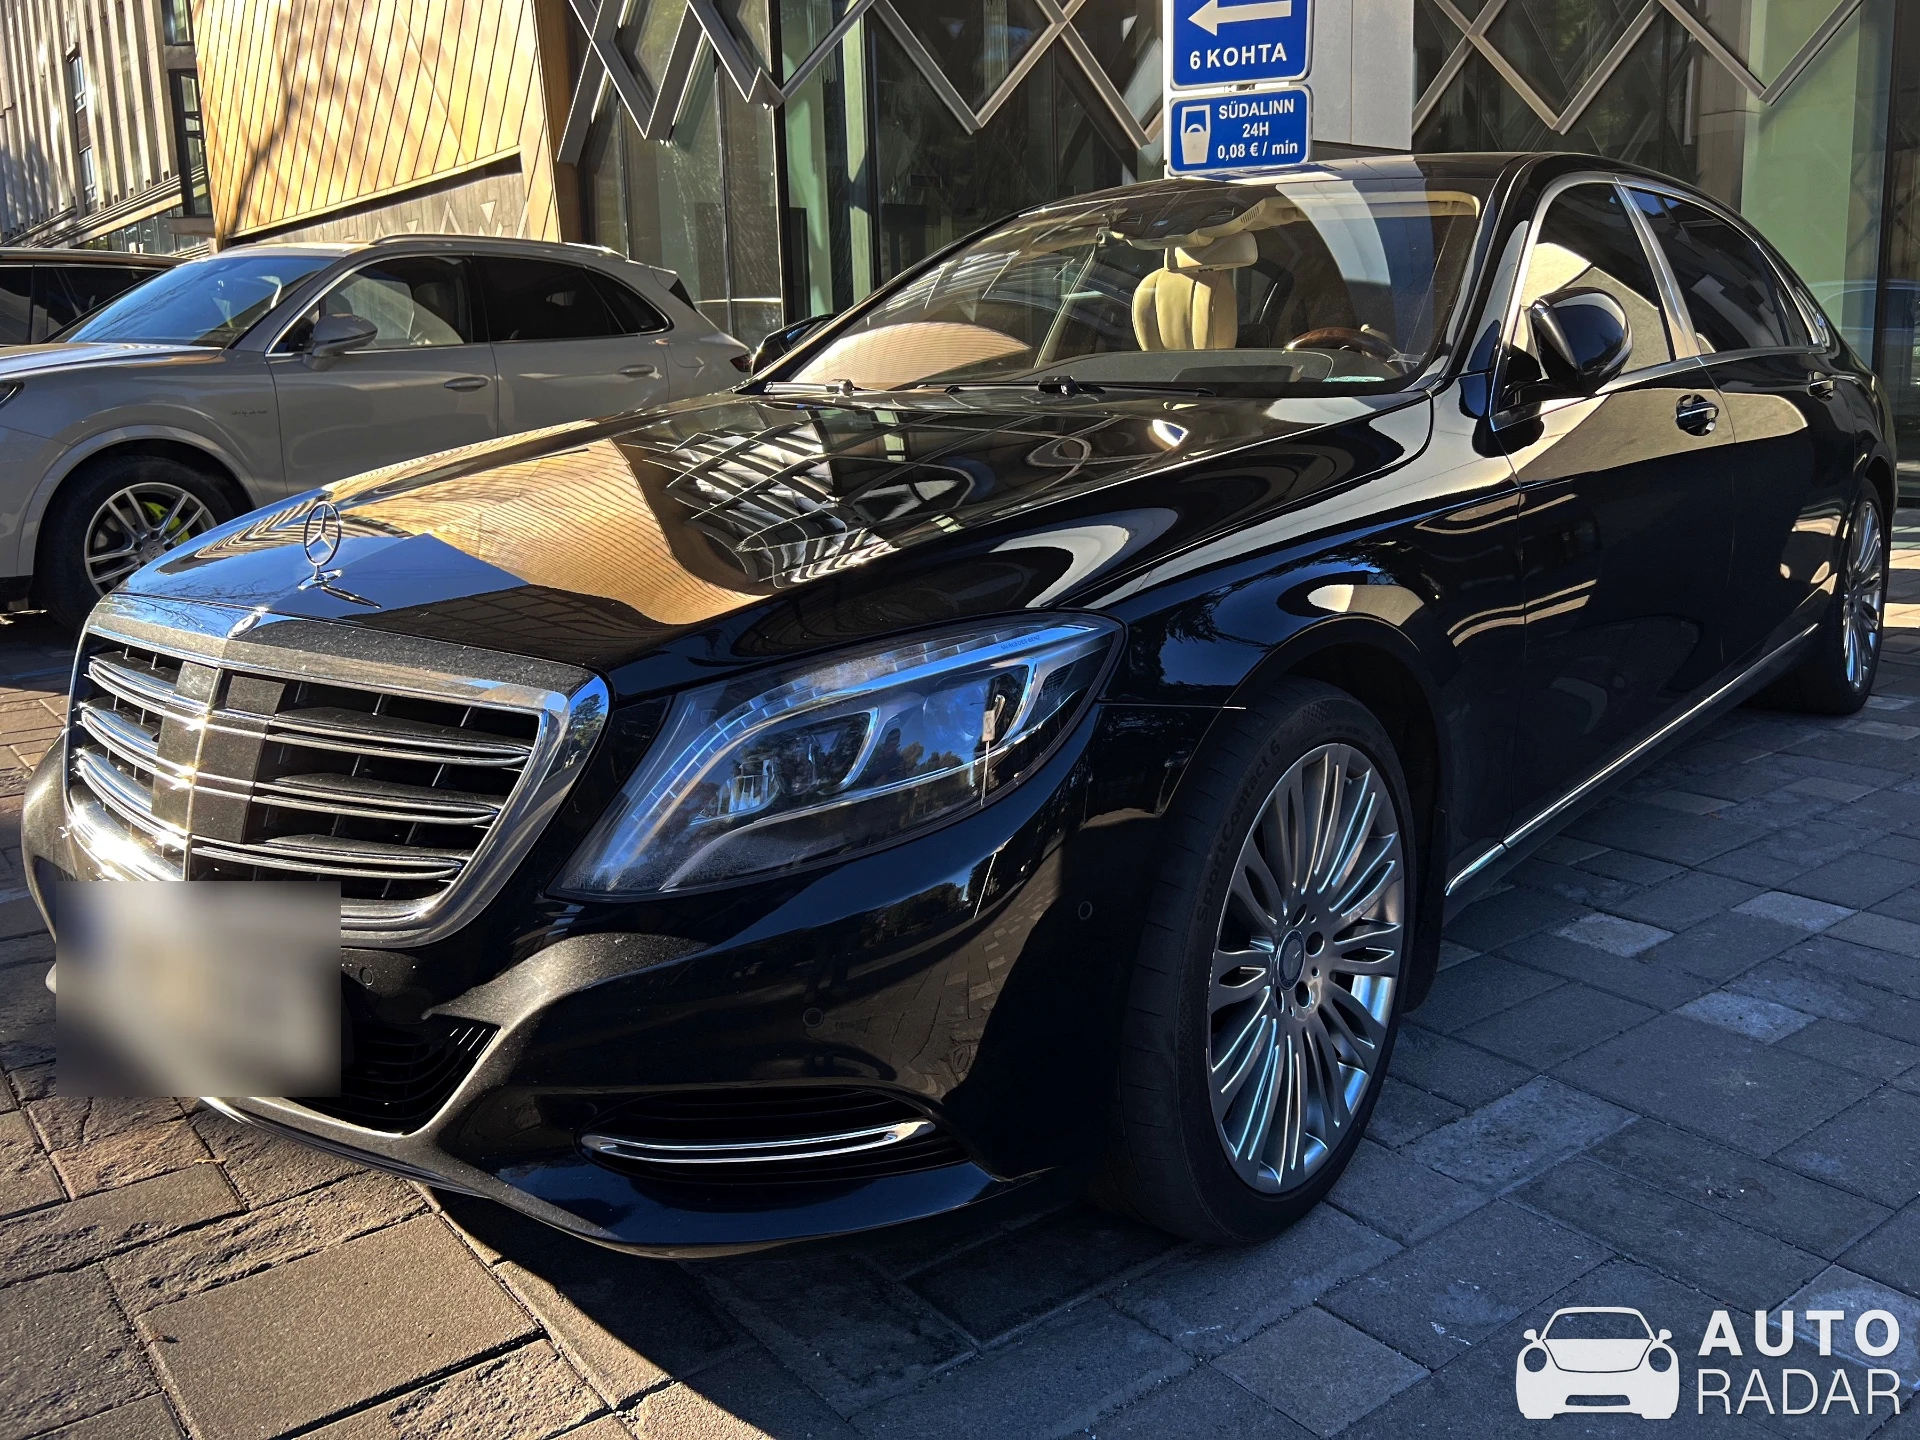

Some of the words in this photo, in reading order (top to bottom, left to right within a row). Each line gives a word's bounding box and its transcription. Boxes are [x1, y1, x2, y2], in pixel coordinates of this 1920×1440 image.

[1190, 51, 1201, 70] 6
[1206, 42, 1287, 69] KOHTA
[1218, 98, 1295, 120] SÜDALINN
[1242, 121, 1269, 138] 24H
[1217, 143, 1246, 161] 0,08
[1250, 142, 1258, 157] €
[1262, 141, 1267, 157] /
[1272, 140, 1298, 156] min
